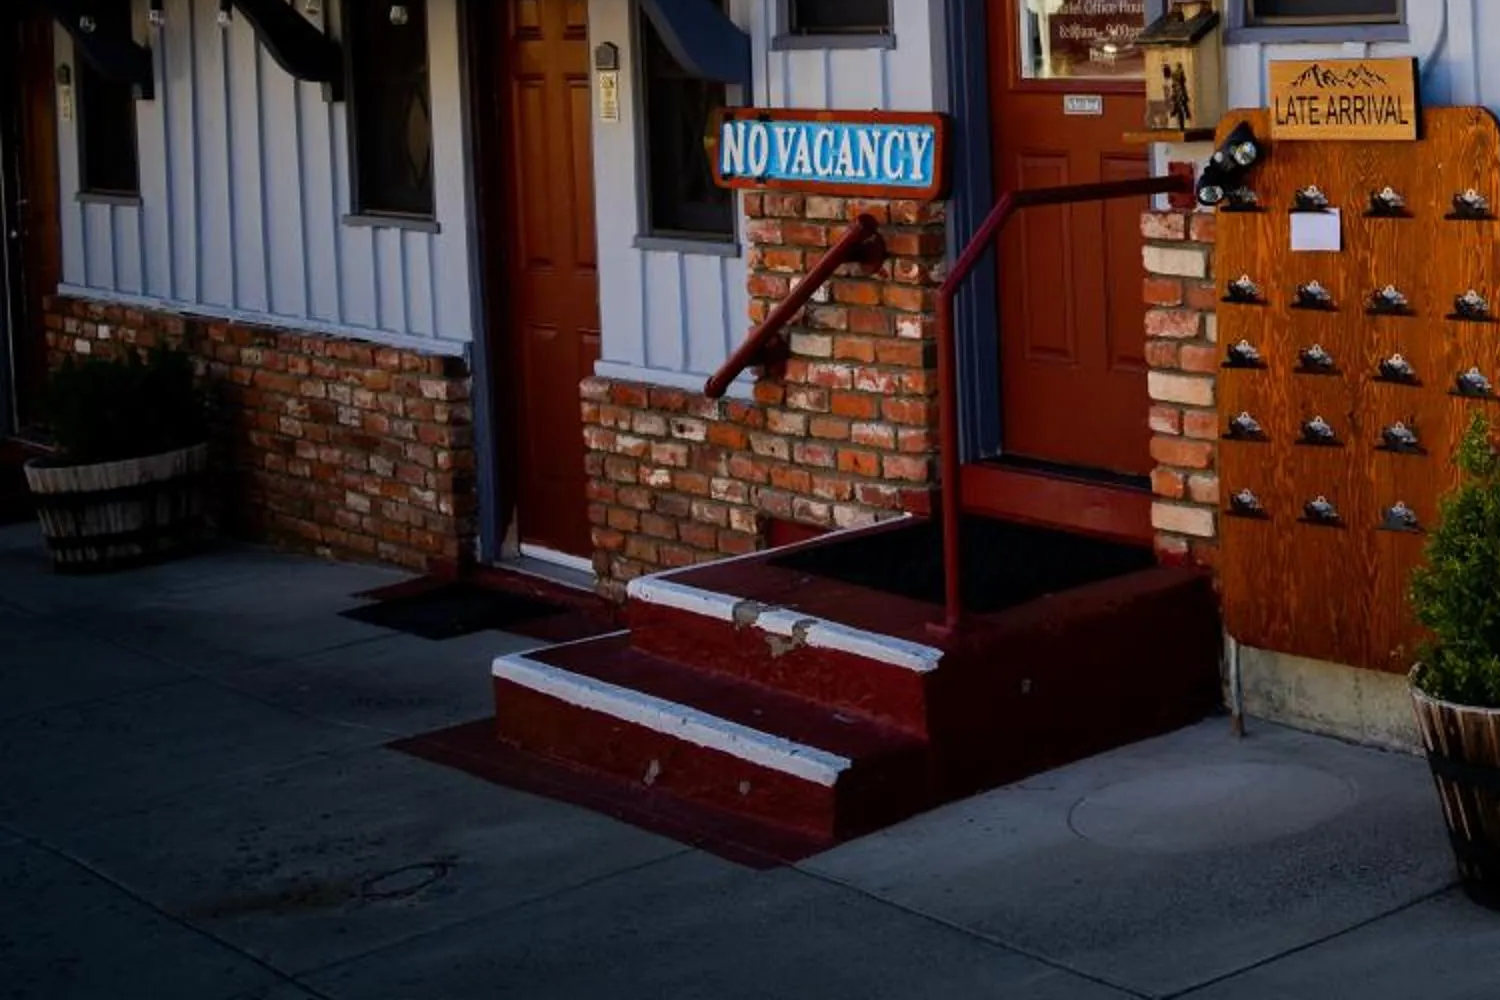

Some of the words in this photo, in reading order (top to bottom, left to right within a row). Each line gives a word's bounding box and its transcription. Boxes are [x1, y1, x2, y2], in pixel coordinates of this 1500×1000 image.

[1084, 0, 1117, 15] Office
[1275, 95, 1321, 126] LATE
[1325, 95, 1409, 126] ARRIVAL
[722, 122, 769, 177] NO
[775, 126, 931, 180] VACANCY
